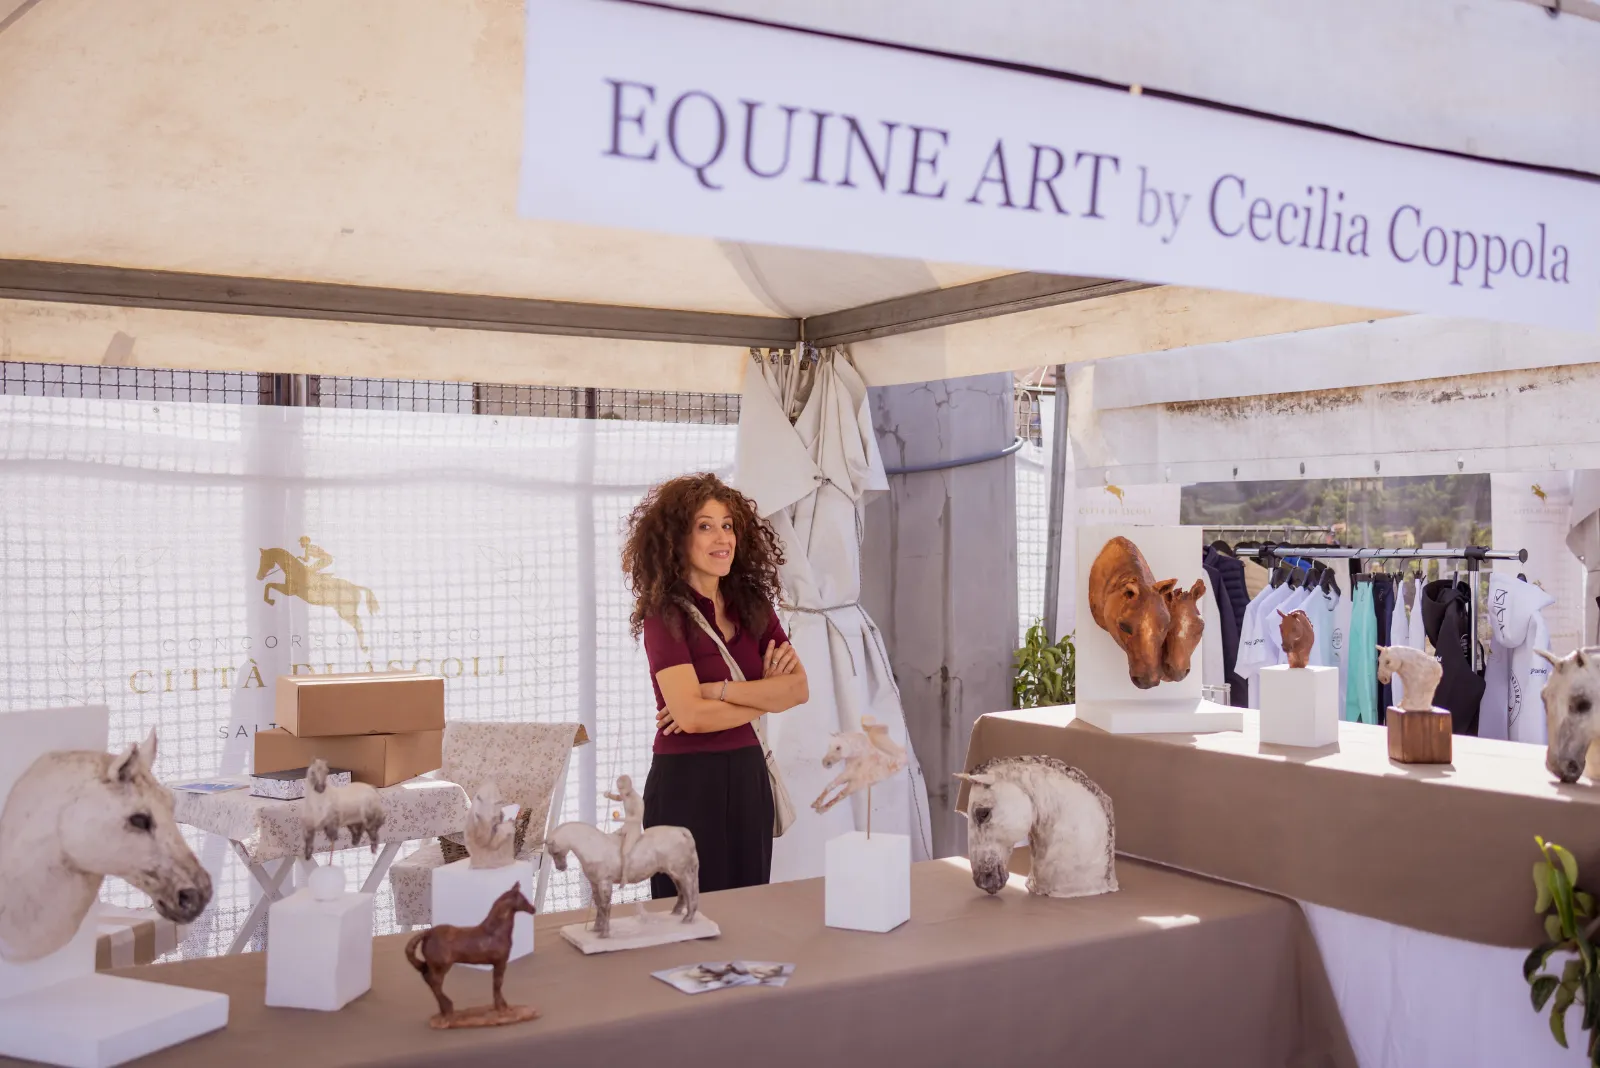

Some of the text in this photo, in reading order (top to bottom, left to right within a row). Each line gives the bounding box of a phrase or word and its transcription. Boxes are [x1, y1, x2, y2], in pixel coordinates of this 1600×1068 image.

[602, 78, 1570, 289] EQUINE ART by Cecilia Coppola
[163, 634, 348, 651] CONCORSO
[129, 658, 267, 694] CITTÀ
